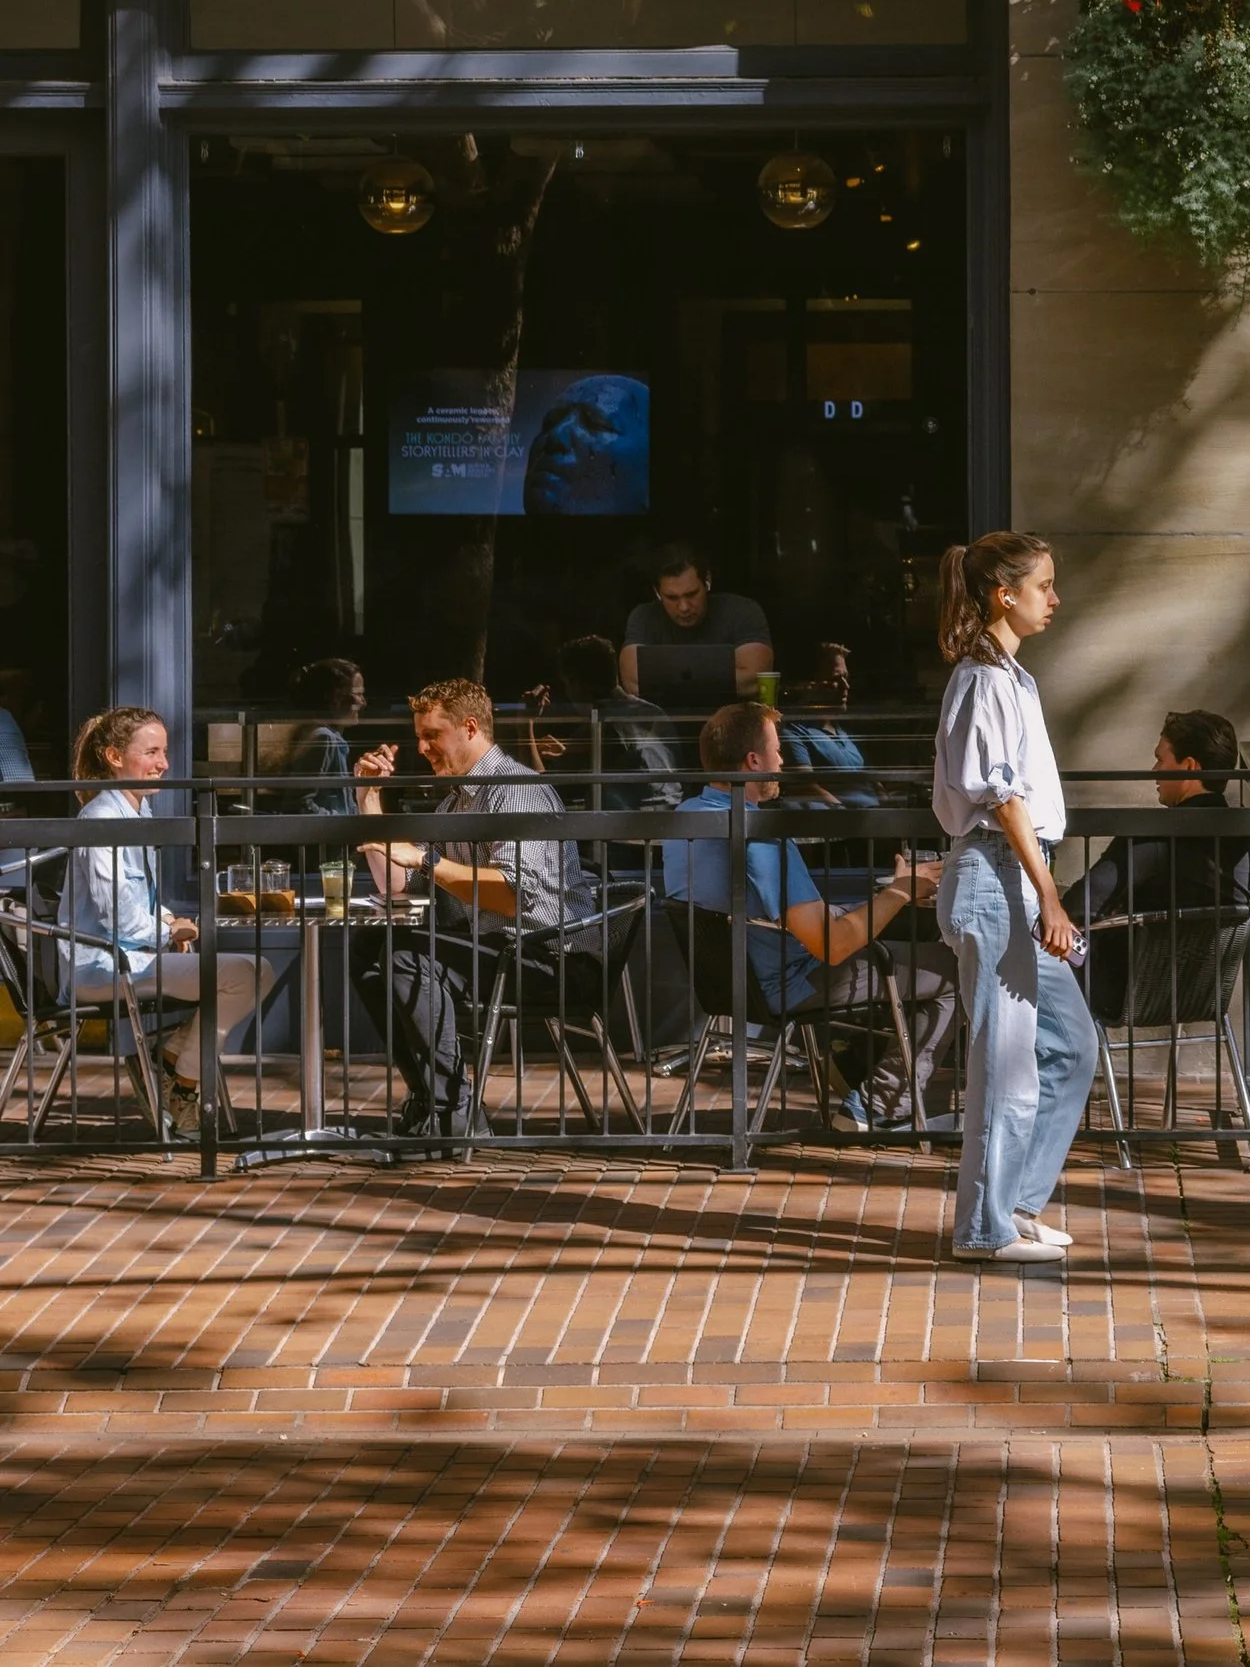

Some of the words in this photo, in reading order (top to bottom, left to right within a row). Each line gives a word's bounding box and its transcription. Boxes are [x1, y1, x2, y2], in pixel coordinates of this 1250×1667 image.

[436, 407, 468, 415] ceramic
[416, 416, 469, 425] continuously
[406, 433, 422, 444] THE
[401, 445, 476, 457] STORYTELLERS
[480, 445, 490, 457] IN
[494, 445, 524, 457] CLAY
